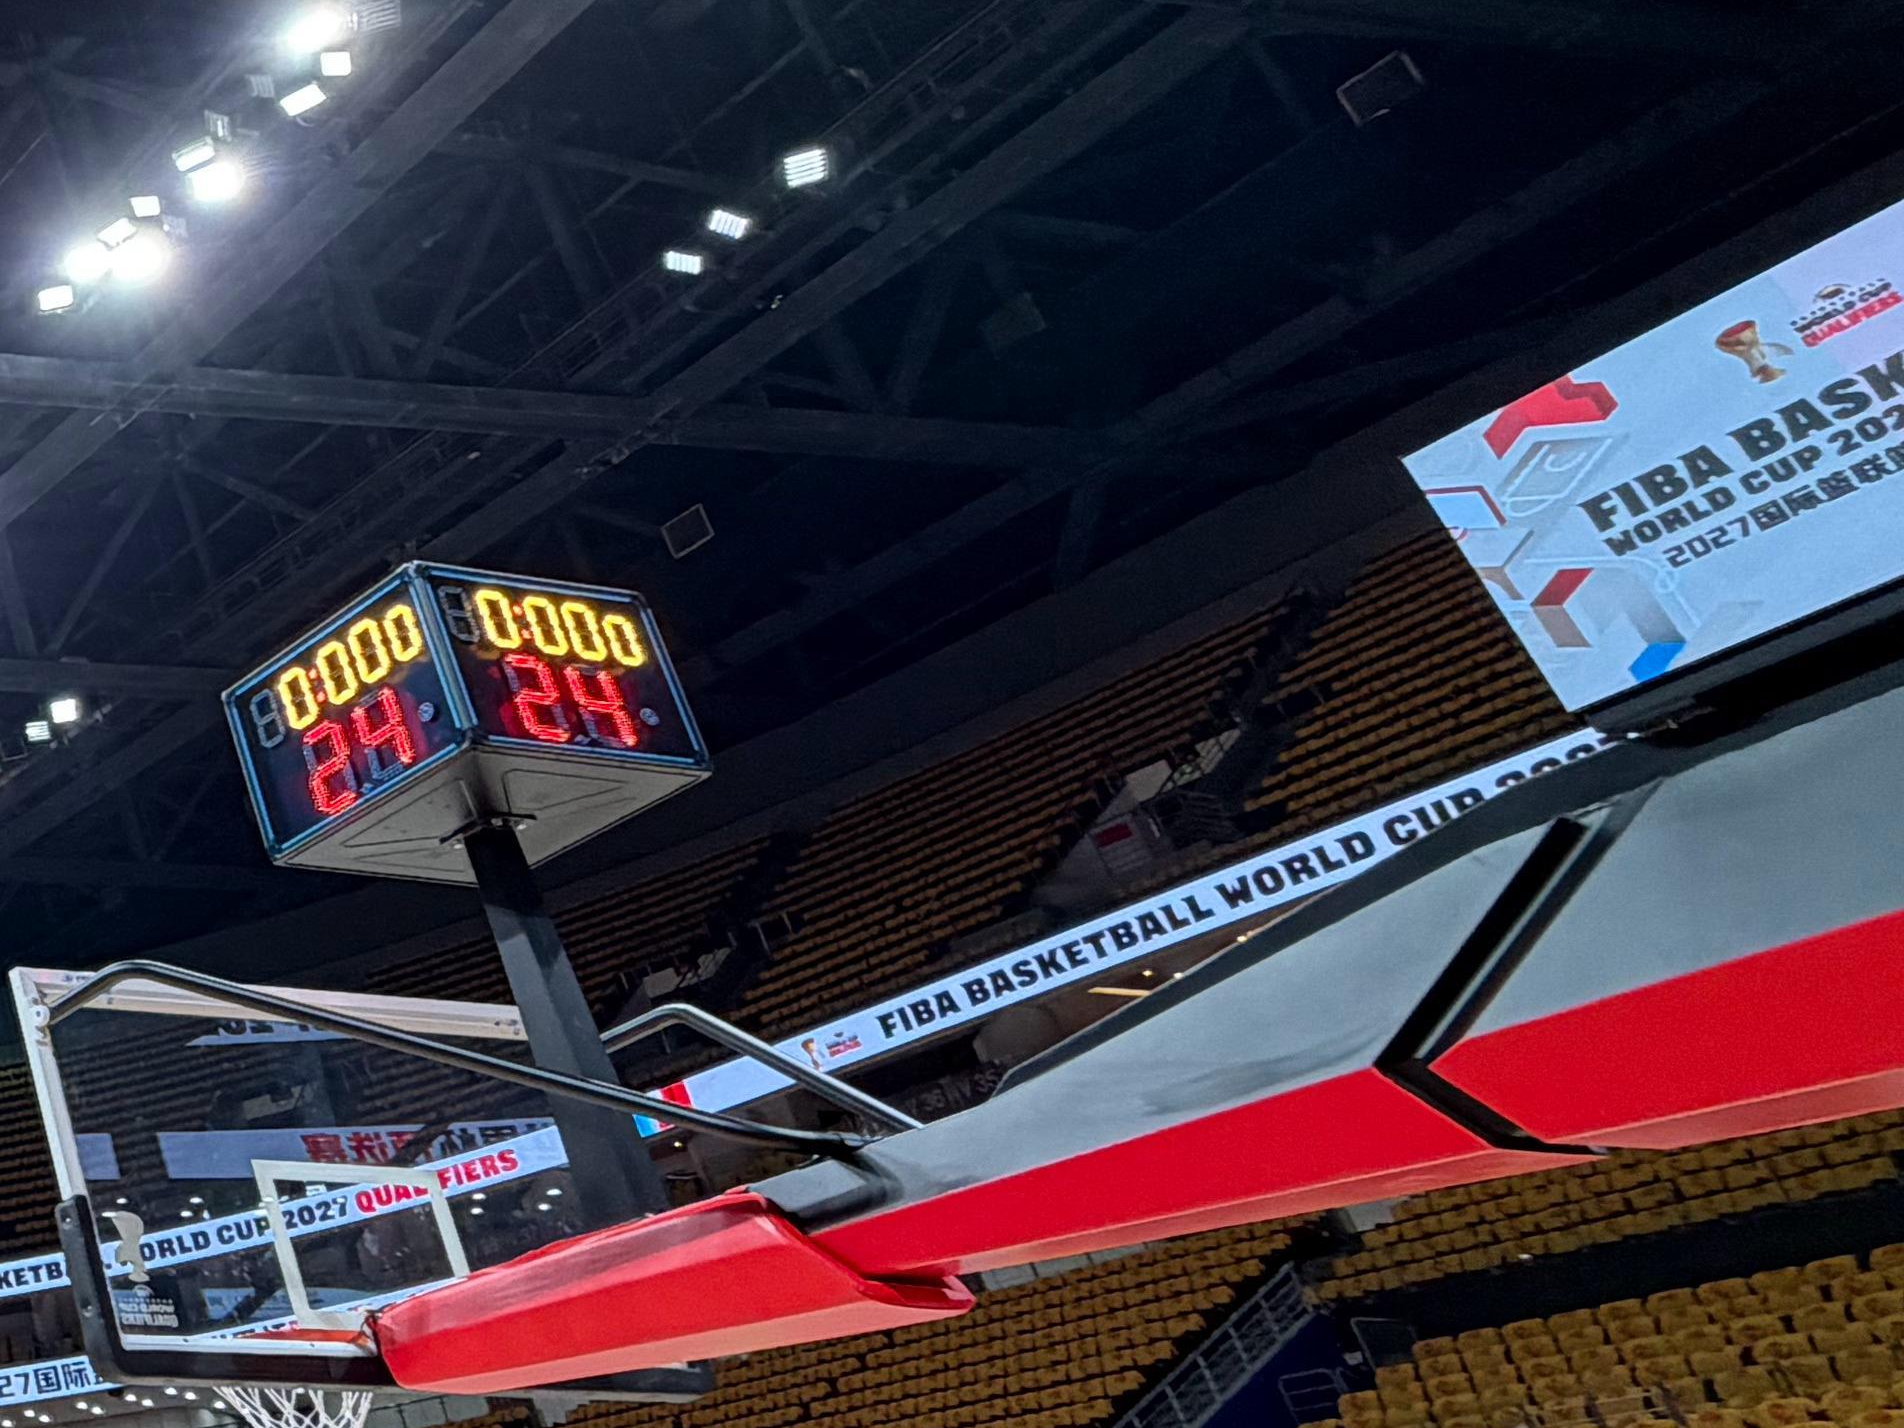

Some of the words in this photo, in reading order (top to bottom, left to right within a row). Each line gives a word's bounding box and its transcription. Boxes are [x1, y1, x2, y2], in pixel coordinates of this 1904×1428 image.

[1578, 445, 1735, 534] FIBA
[1602, 486, 1737, 558] WORLD
[1739, 444, 1823, 495] CUP
[302, 685, 416, 816] 24
[502, 653, 638, 748] 24
[878, 990, 961, 1042] FIBA
[960, 894, 1216, 1006] BASKETBALL
[1217, 829, 1377, 911] WORLD
[216, 1215, 270, 1247] CUP
[284, 1196, 350, 1229] 2027
